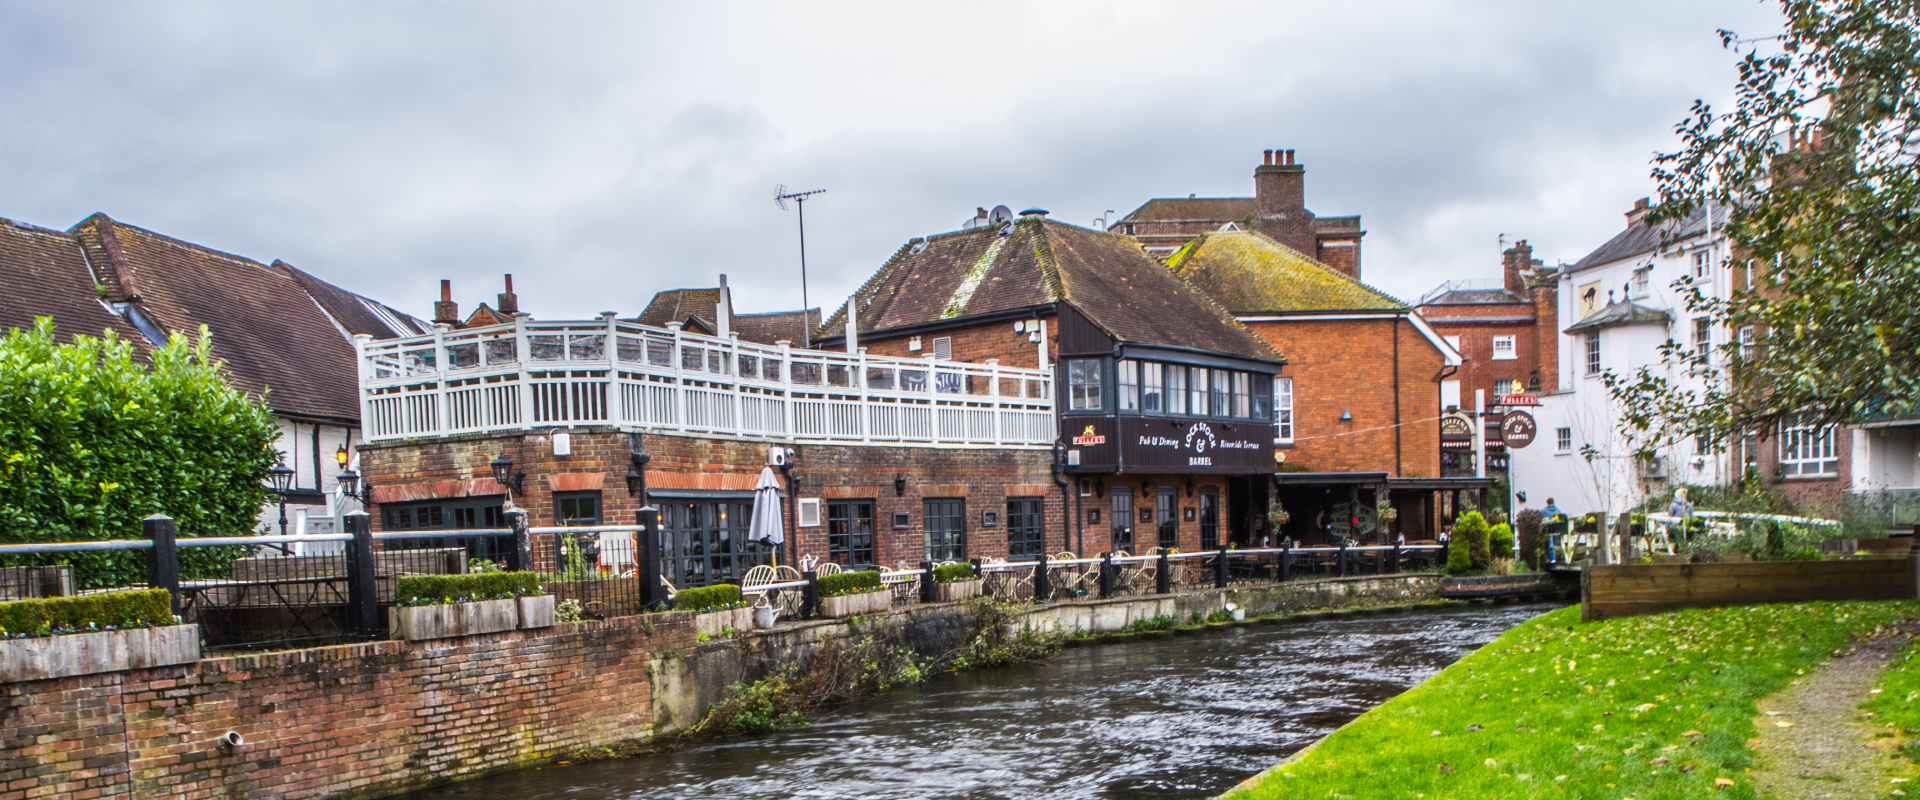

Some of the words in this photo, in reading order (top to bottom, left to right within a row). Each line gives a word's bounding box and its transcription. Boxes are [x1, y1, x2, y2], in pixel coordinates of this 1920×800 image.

[1504, 416, 1517, 430] LOCK
[1517, 415, 1533, 429] STOCK
[1514, 424, 1523, 433] &
[1185, 423, 1198, 448] LOCK
[1199, 422, 1216, 449] STOCK
[1139, 436, 1150, 445] Pub
[1159, 437, 1179, 449] Dining
[1196, 438, 1205, 453] &
[1220, 439, 1243, 449] Riverside
[1243, 440, 1260, 450] Terrace
[1189, 457, 1212, 466] BARREL
